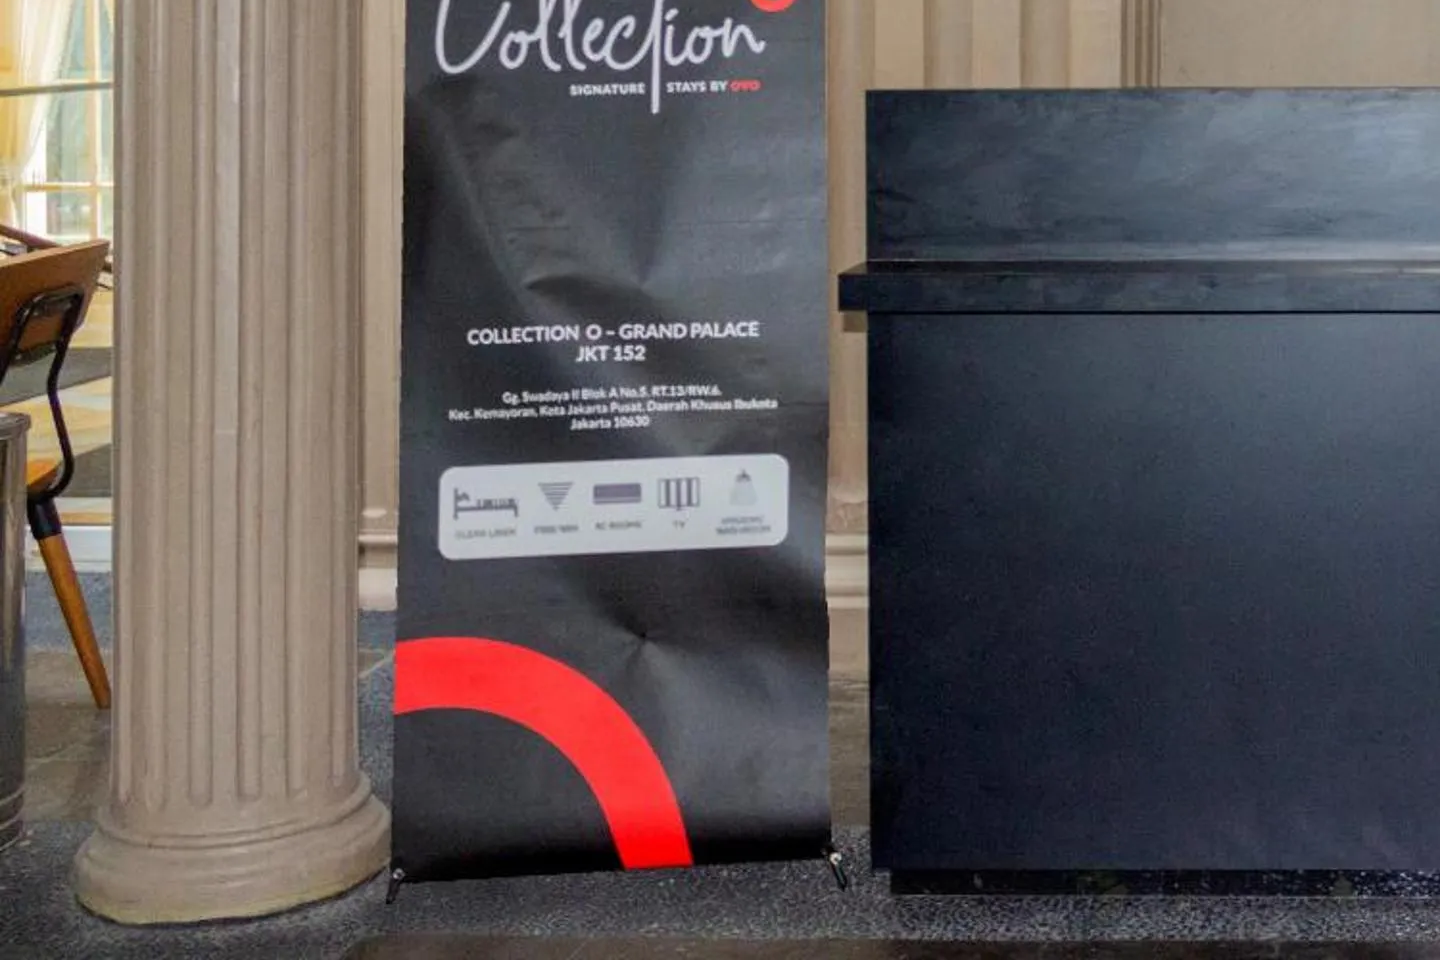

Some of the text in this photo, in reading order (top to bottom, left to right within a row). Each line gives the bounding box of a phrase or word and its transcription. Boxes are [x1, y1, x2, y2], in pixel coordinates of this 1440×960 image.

[569, 82, 646, 97] SIGNATURE
[666, 80, 707, 94] STAYS
[709, 79, 729, 92] BY
[467, 324, 579, 345] COLLECTION
[586, 324, 602, 341] O
[619, 322, 688, 340] GRAND
[690, 320, 760, 339] PALACE
[575, 344, 646, 363] JKT 152
[608, 386, 618, 399] A
[567, 403, 609, 416] Jakarta
[647, 400, 690, 412] Daerah
[570, 414, 649, 431] Jakarta 10630
